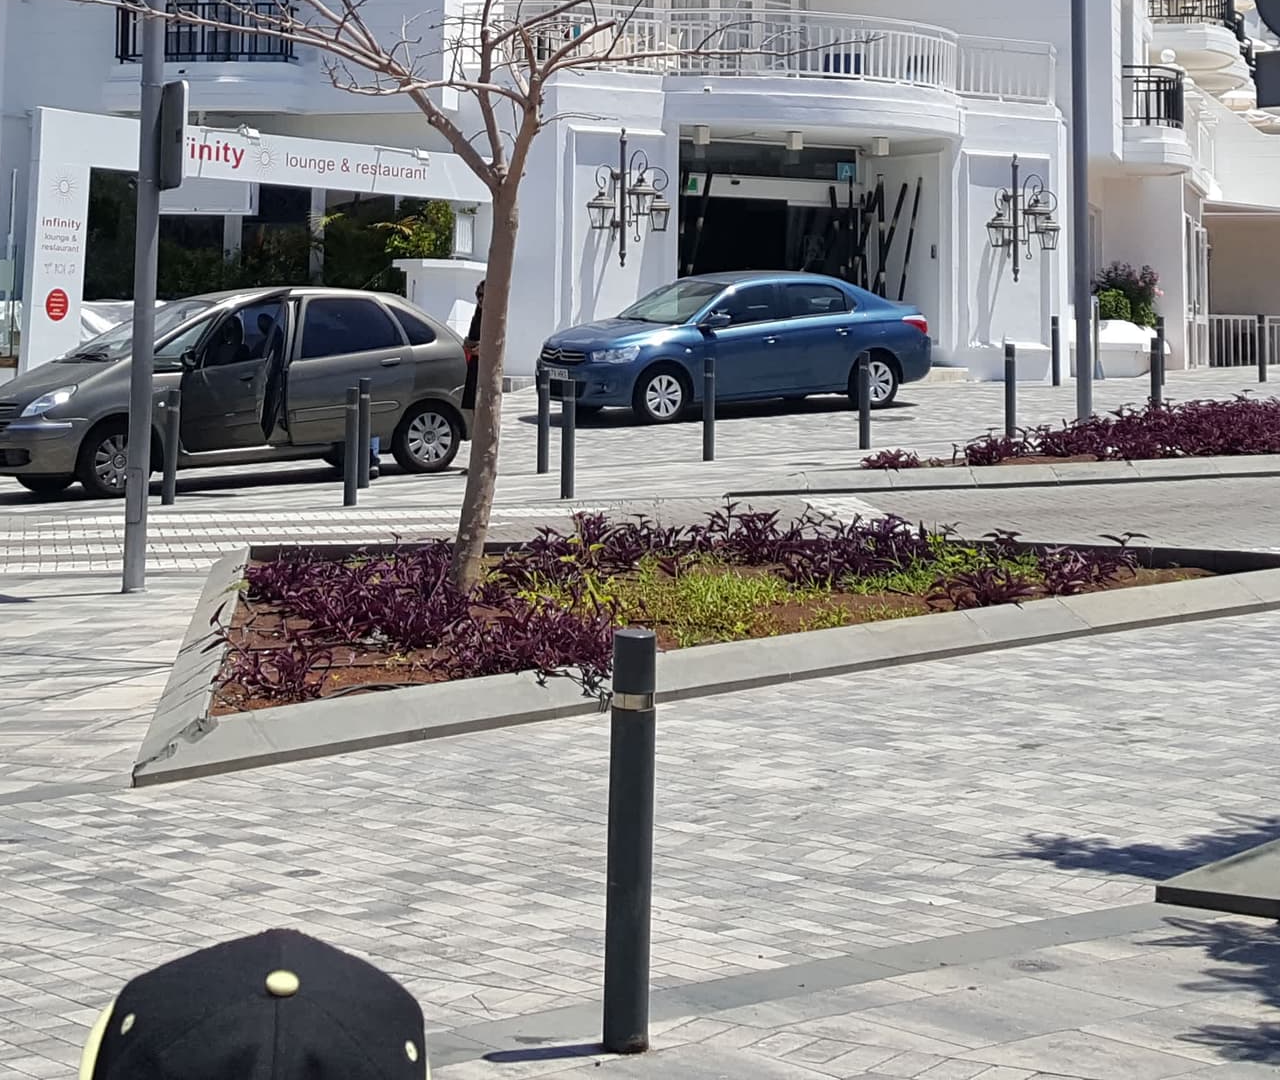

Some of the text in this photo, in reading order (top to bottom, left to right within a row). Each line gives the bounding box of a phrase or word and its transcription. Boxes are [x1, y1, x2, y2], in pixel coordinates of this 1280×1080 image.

[187, 137, 426, 180] inity lounge & restaurant
[42, 217, 81, 231] infinity
